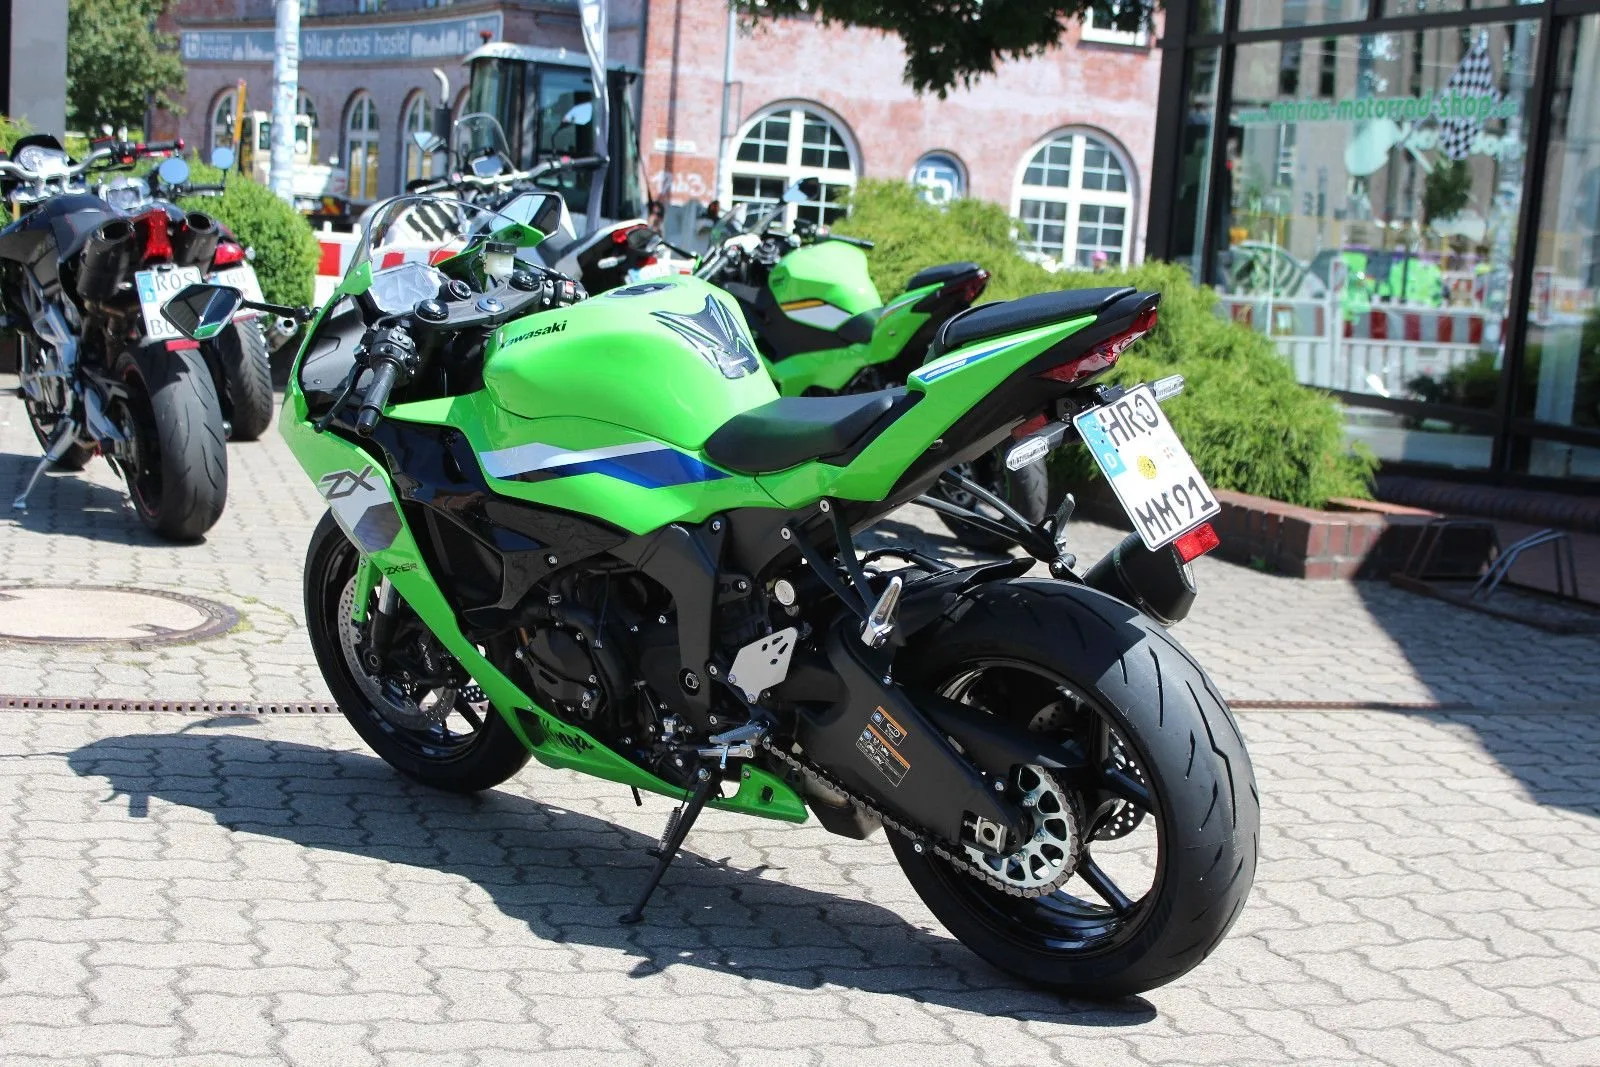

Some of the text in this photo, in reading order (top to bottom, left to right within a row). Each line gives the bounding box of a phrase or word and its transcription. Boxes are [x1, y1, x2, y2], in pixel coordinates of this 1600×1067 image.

[305, 33, 333, 57] blue
[374, 28, 410, 55] hostel
[155, 271, 194, 291] ROS
[498, 319, 568, 352] Kawasaki
[1099, 393, 1159, 447] HRO
[319, 464, 377, 500] ZX
[384, 562, 419, 576] ZX-6R
